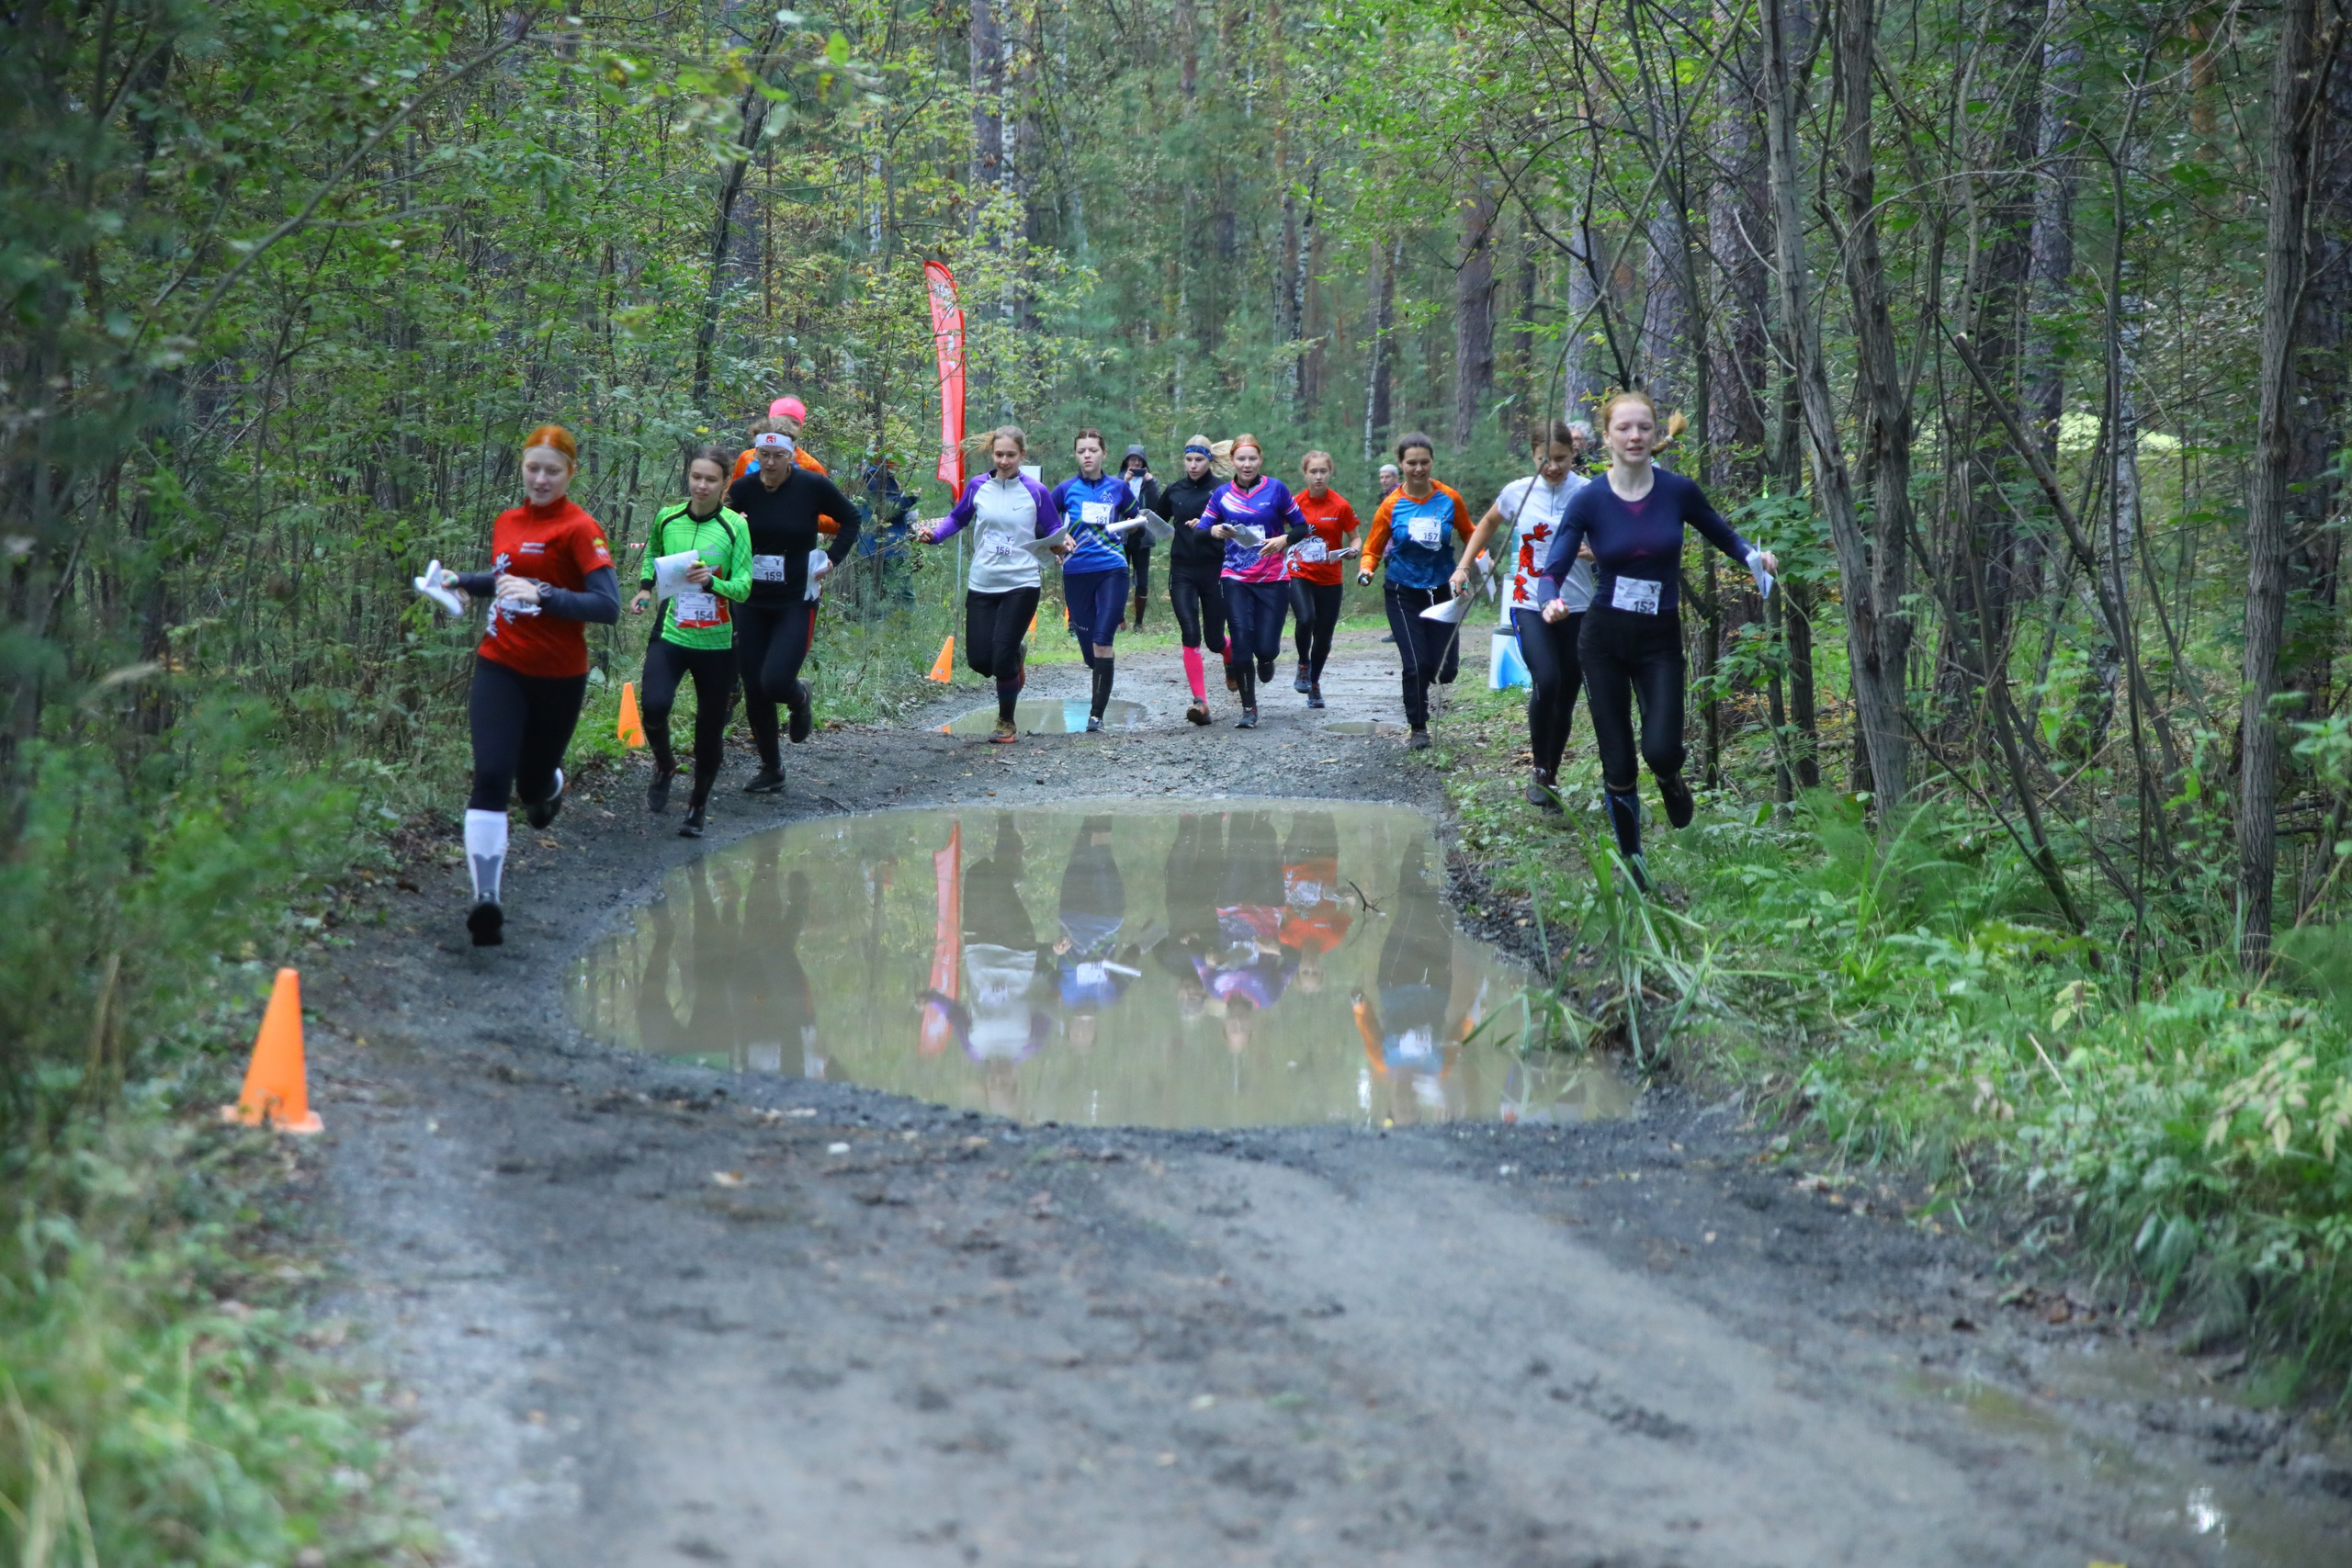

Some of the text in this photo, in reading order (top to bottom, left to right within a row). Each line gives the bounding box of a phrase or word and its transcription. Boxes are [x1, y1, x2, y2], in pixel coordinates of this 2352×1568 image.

[1095, 515, 1108, 525] 151
[1423, 532, 1439, 541] 157
[996, 546, 1011, 557] 158
[764, 571, 783, 581] 159
[1634, 600, 1657, 615] 152
[695, 610, 714, 621] 154
